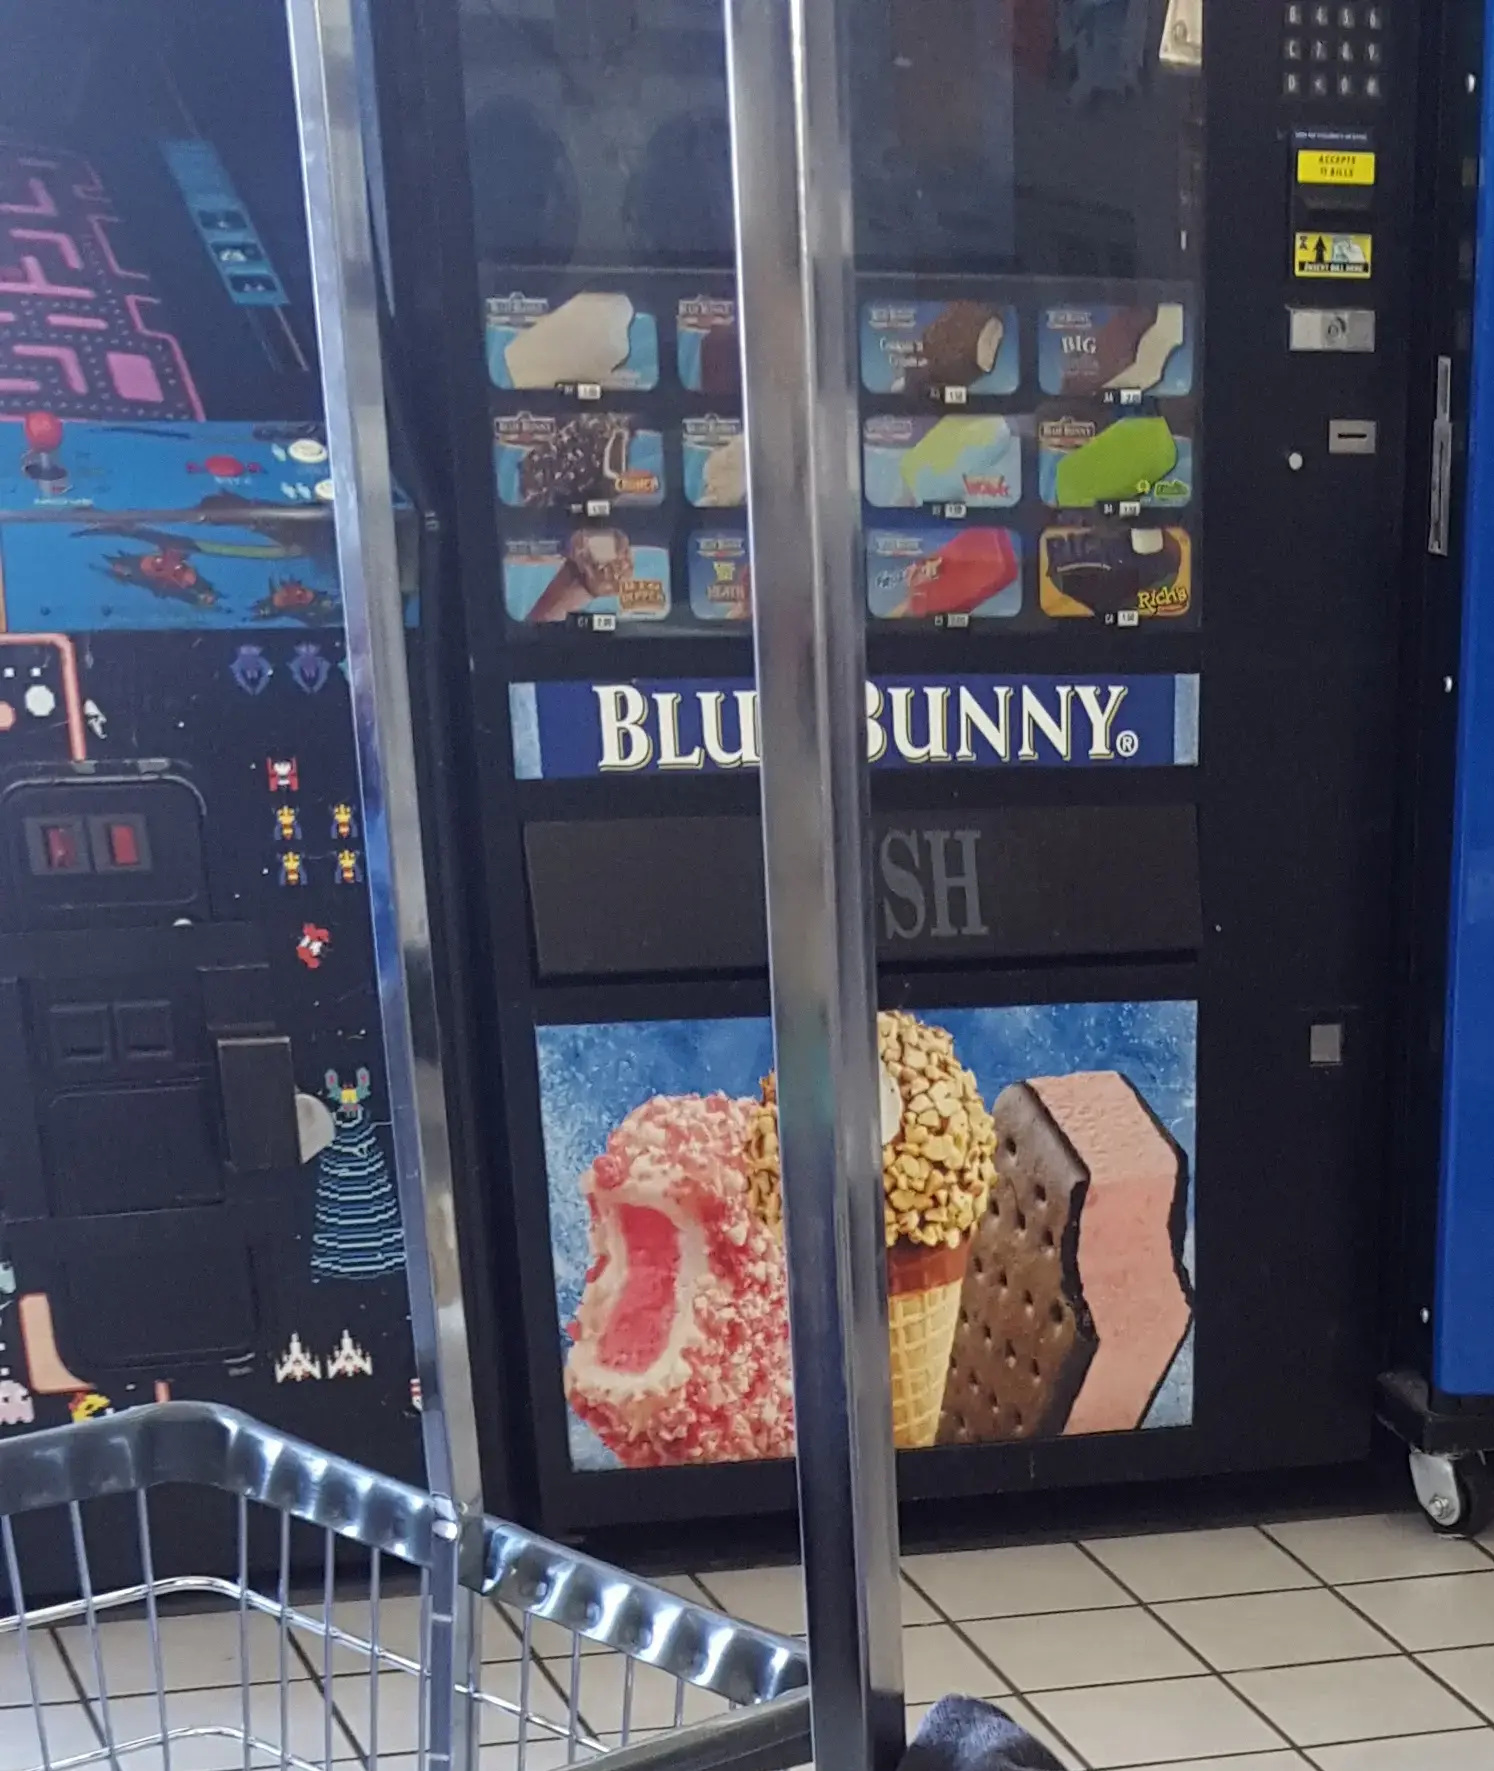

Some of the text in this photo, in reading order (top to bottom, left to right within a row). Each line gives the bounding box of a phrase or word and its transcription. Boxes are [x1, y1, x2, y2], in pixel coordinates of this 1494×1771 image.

[1061, 335, 1097, 354] BIG
[1137, 587, 1188, 613] Rich's
[592, 684, 760, 772] BLU
[878, 829, 989, 940] SH
